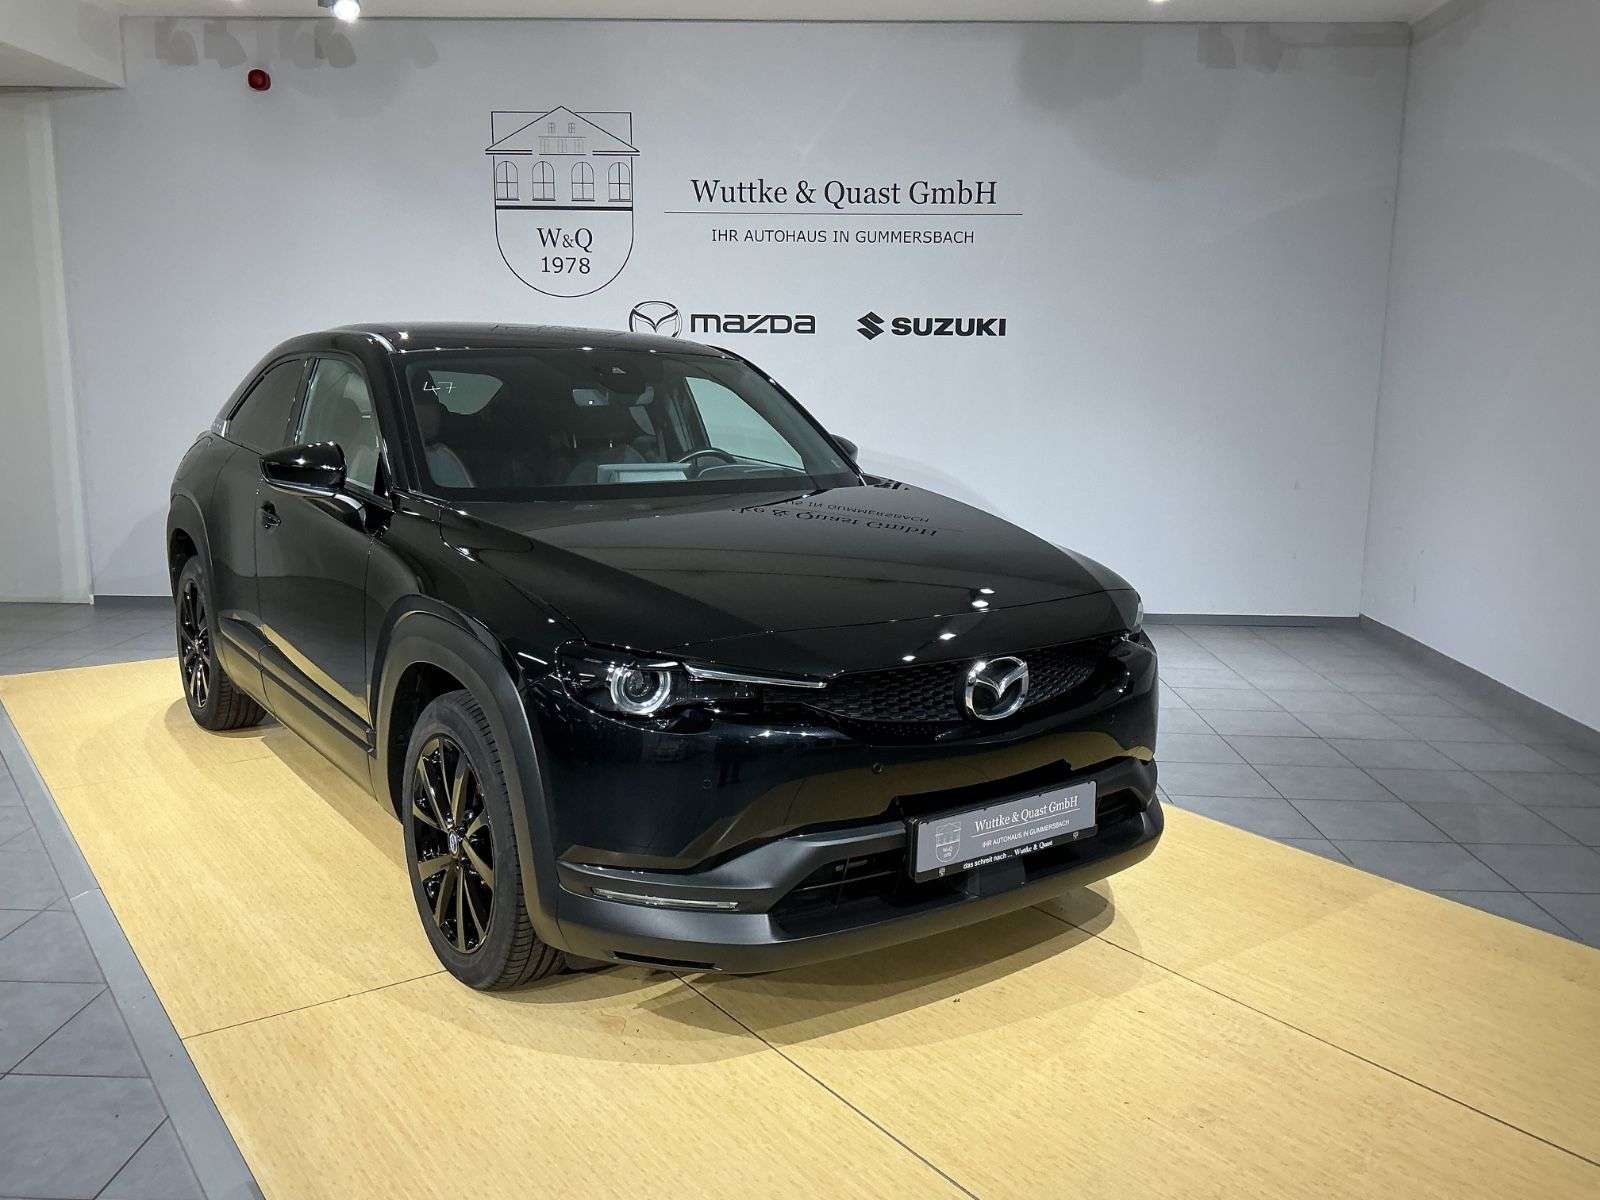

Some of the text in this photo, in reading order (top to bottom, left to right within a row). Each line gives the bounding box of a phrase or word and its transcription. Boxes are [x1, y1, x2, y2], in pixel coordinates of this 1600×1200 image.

[690, 179, 998, 209] Wuttke & Quast GmbH
[536, 227, 593, 249] W&Q
[711, 229, 975, 245] IHR AUTOHAUS IN GUMMERSBACH
[540, 256, 592, 275] 1978
[891, 316, 1007, 336] SUZUKI
[975, 796, 1078, 832] Wuttke & Quast GmbH
